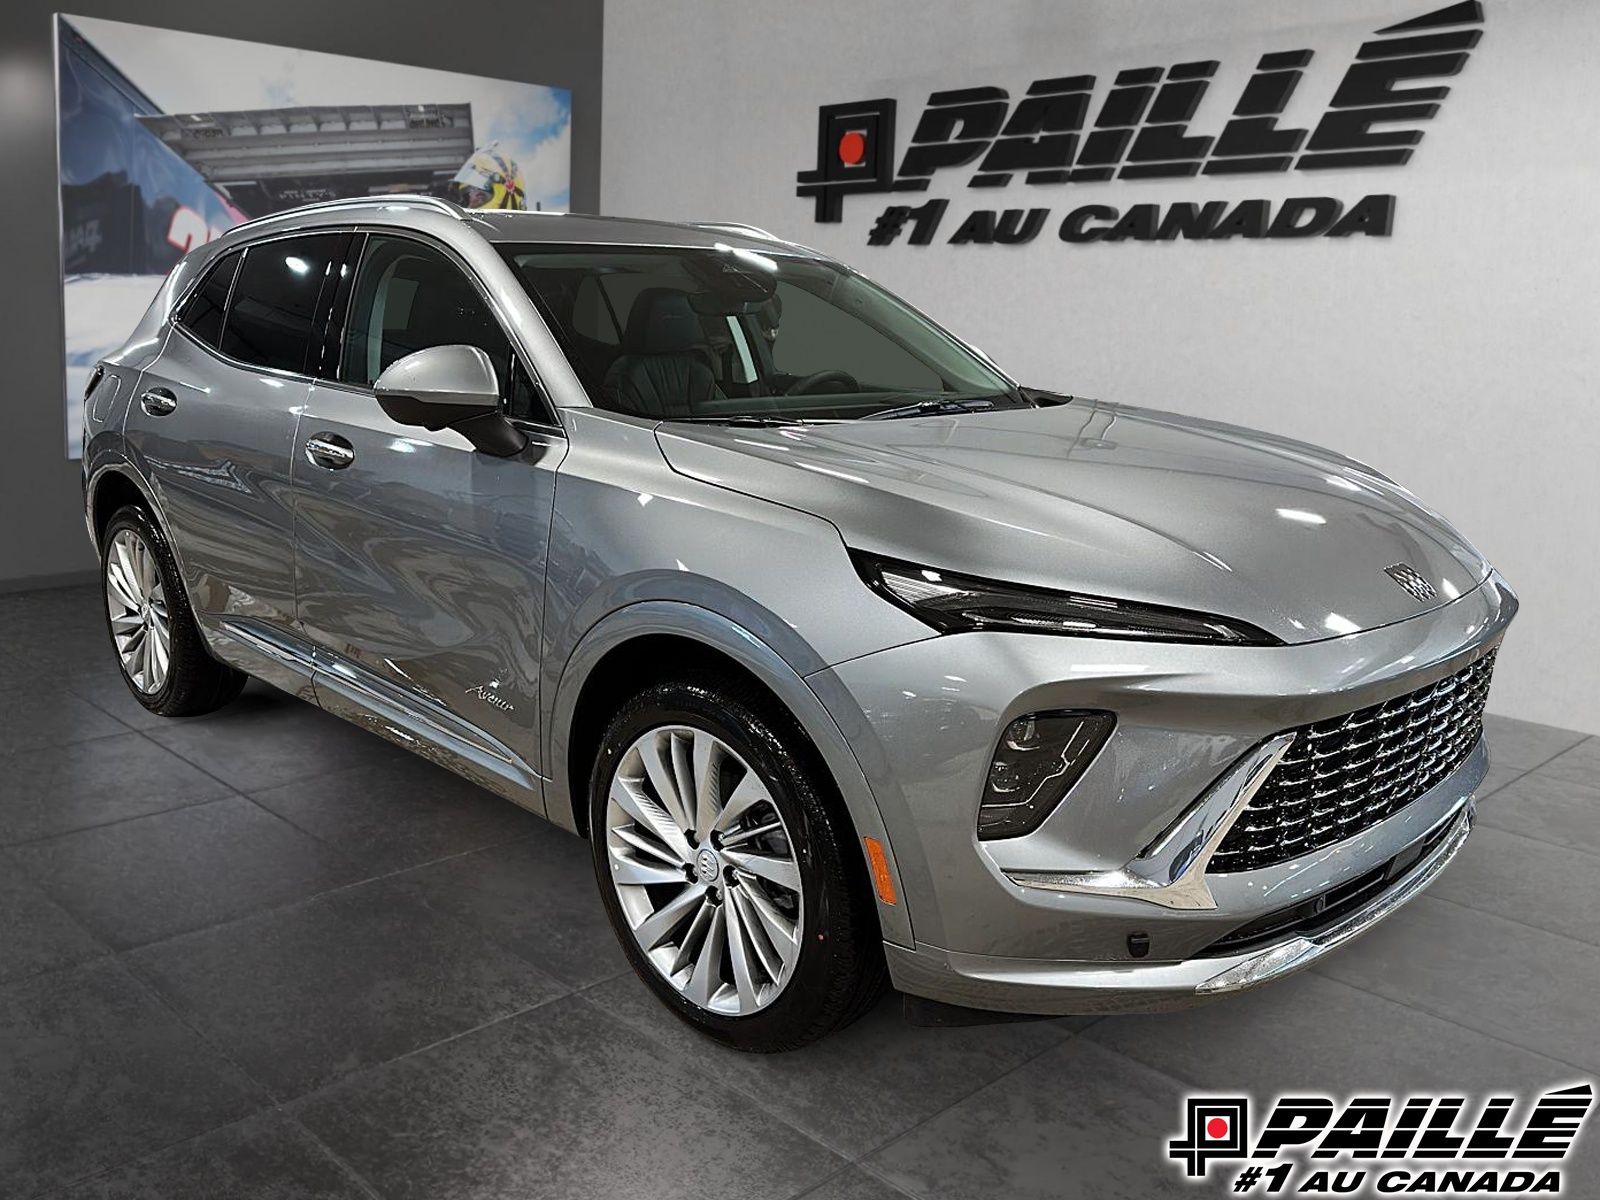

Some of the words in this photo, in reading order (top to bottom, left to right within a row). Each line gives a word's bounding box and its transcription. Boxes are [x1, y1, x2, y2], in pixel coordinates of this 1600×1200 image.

[892, 0, 1485, 192] PAILLÉ
[866, 198, 949, 246] #1
[947, 207, 1051, 245] AU
[1058, 194, 1397, 245] CANADA
